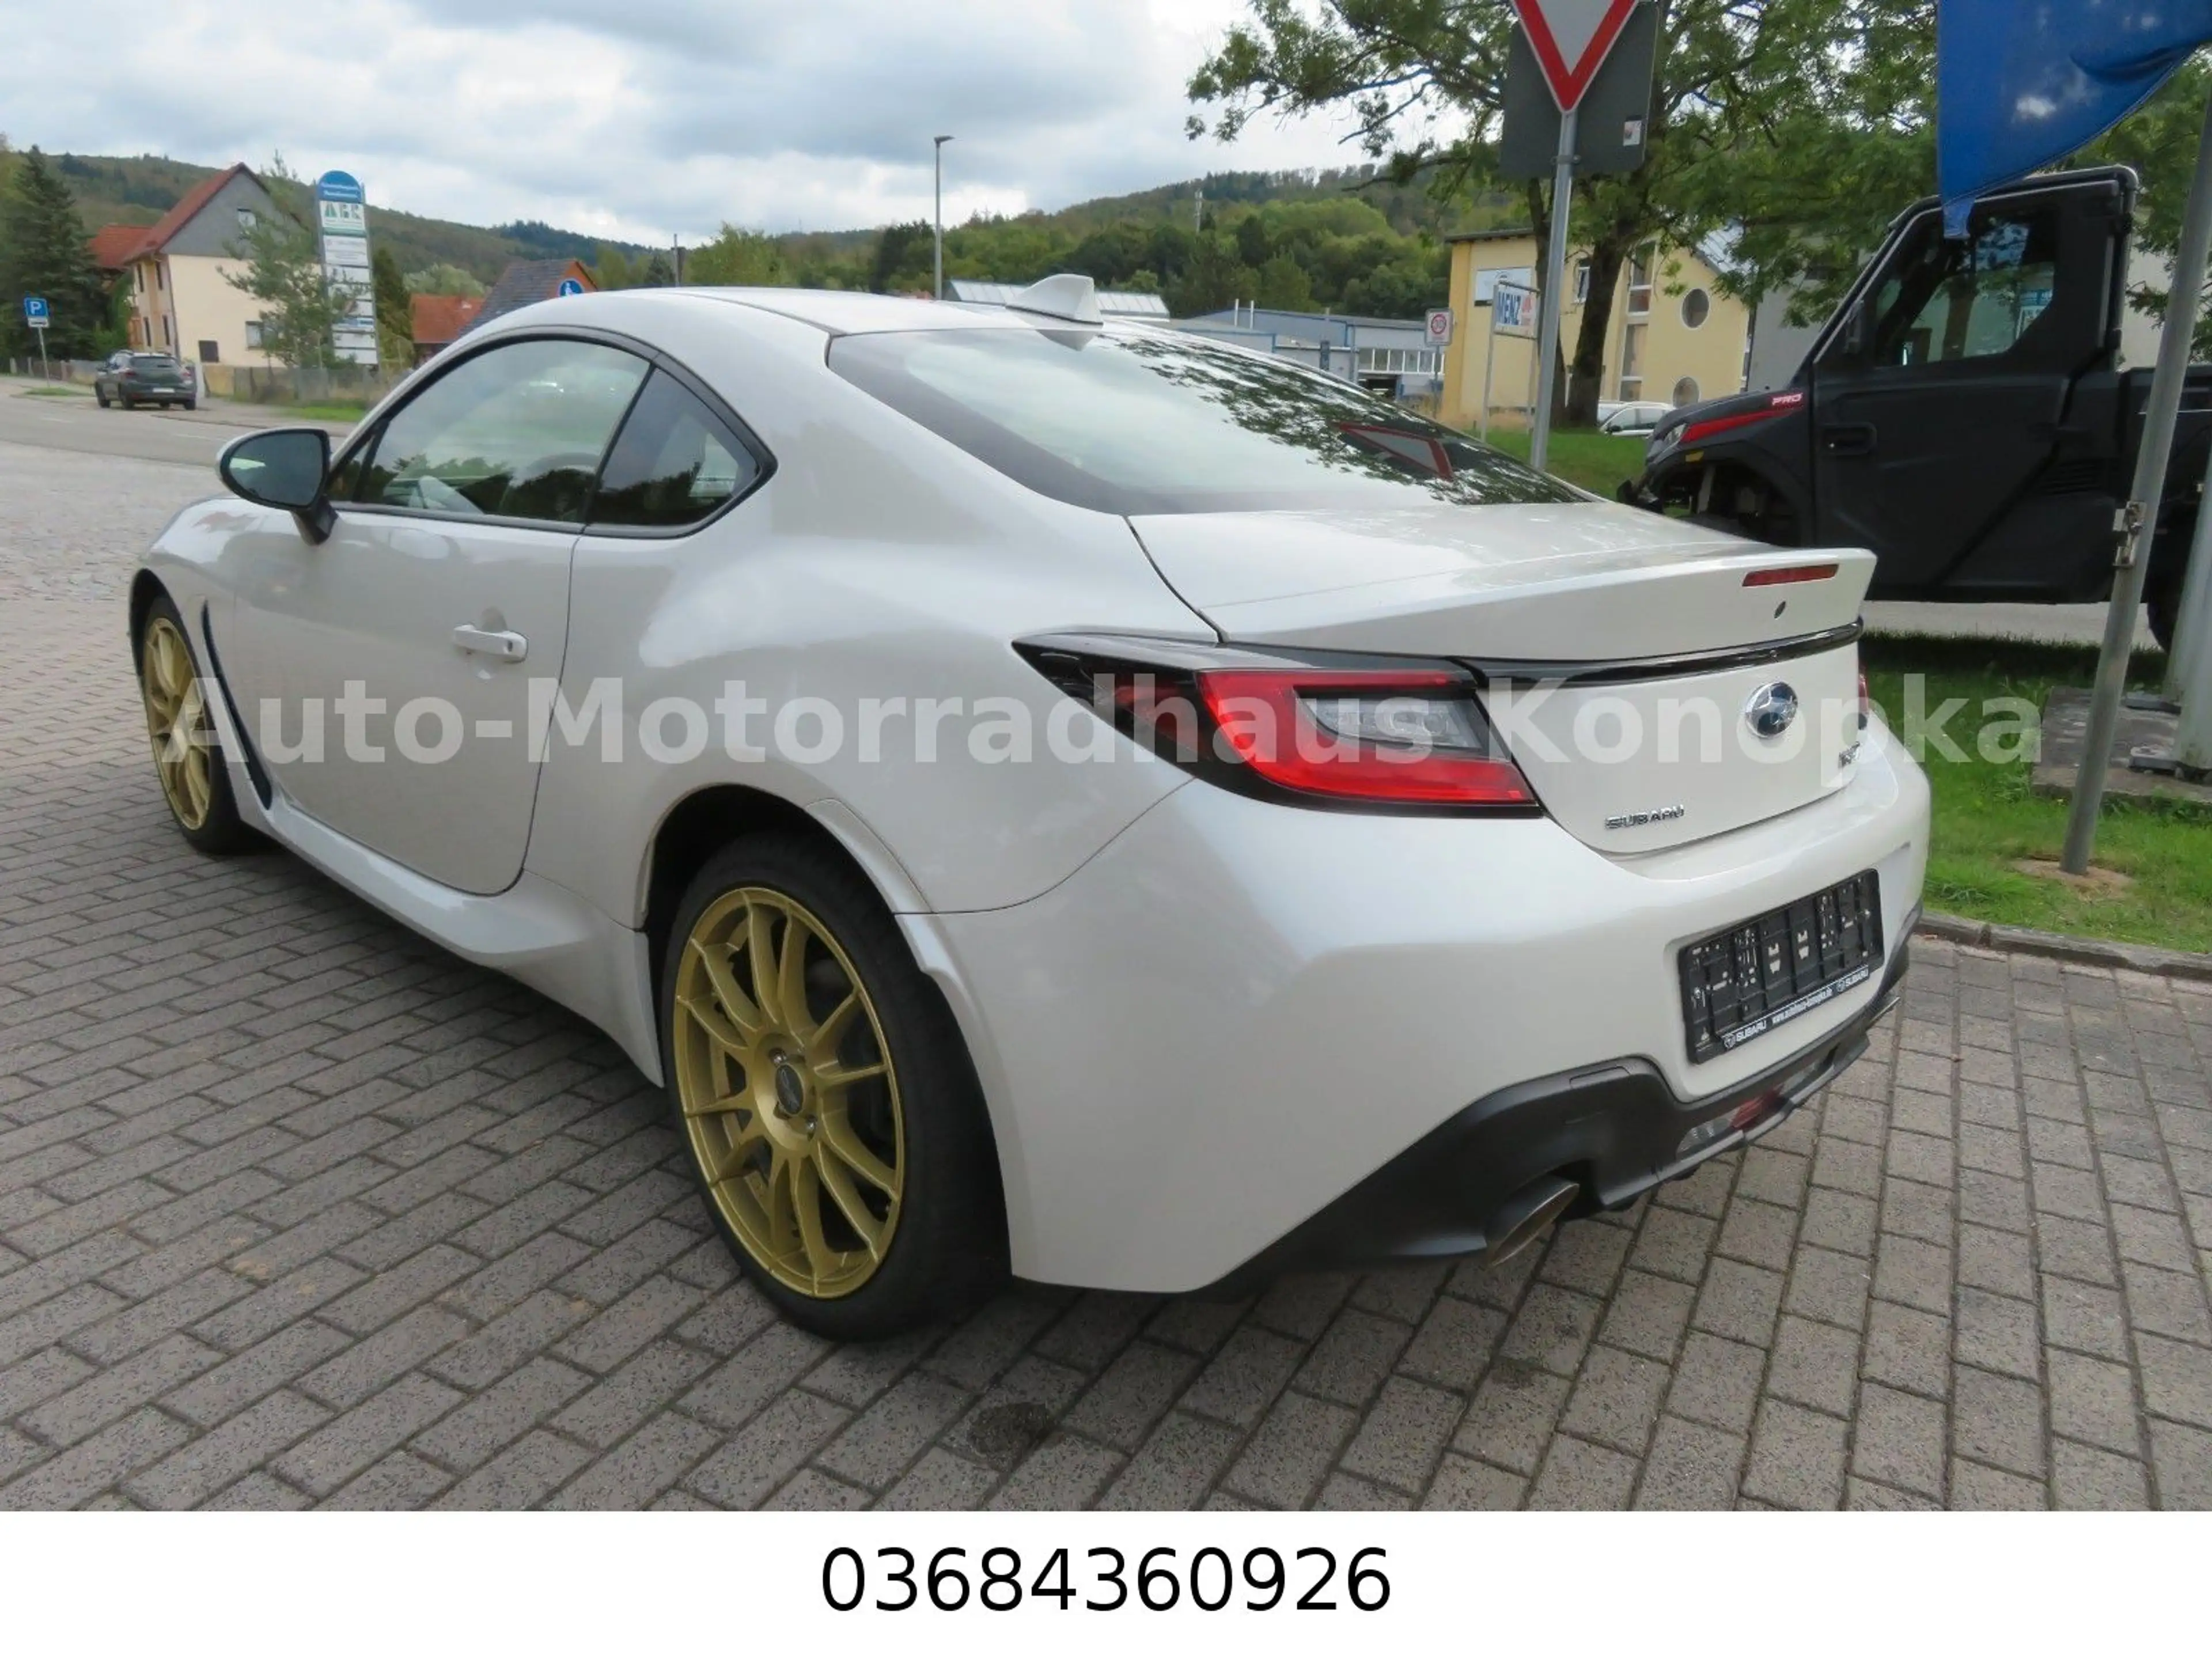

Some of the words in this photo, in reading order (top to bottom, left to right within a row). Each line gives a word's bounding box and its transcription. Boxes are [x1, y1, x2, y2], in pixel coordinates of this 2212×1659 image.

[30, 301, 42, 315] P
[1772, 393, 1803, 406] PRO
[1604, 804, 1685, 829] SUBARU
[1736, 1020, 1767, 1042] SUBARU
